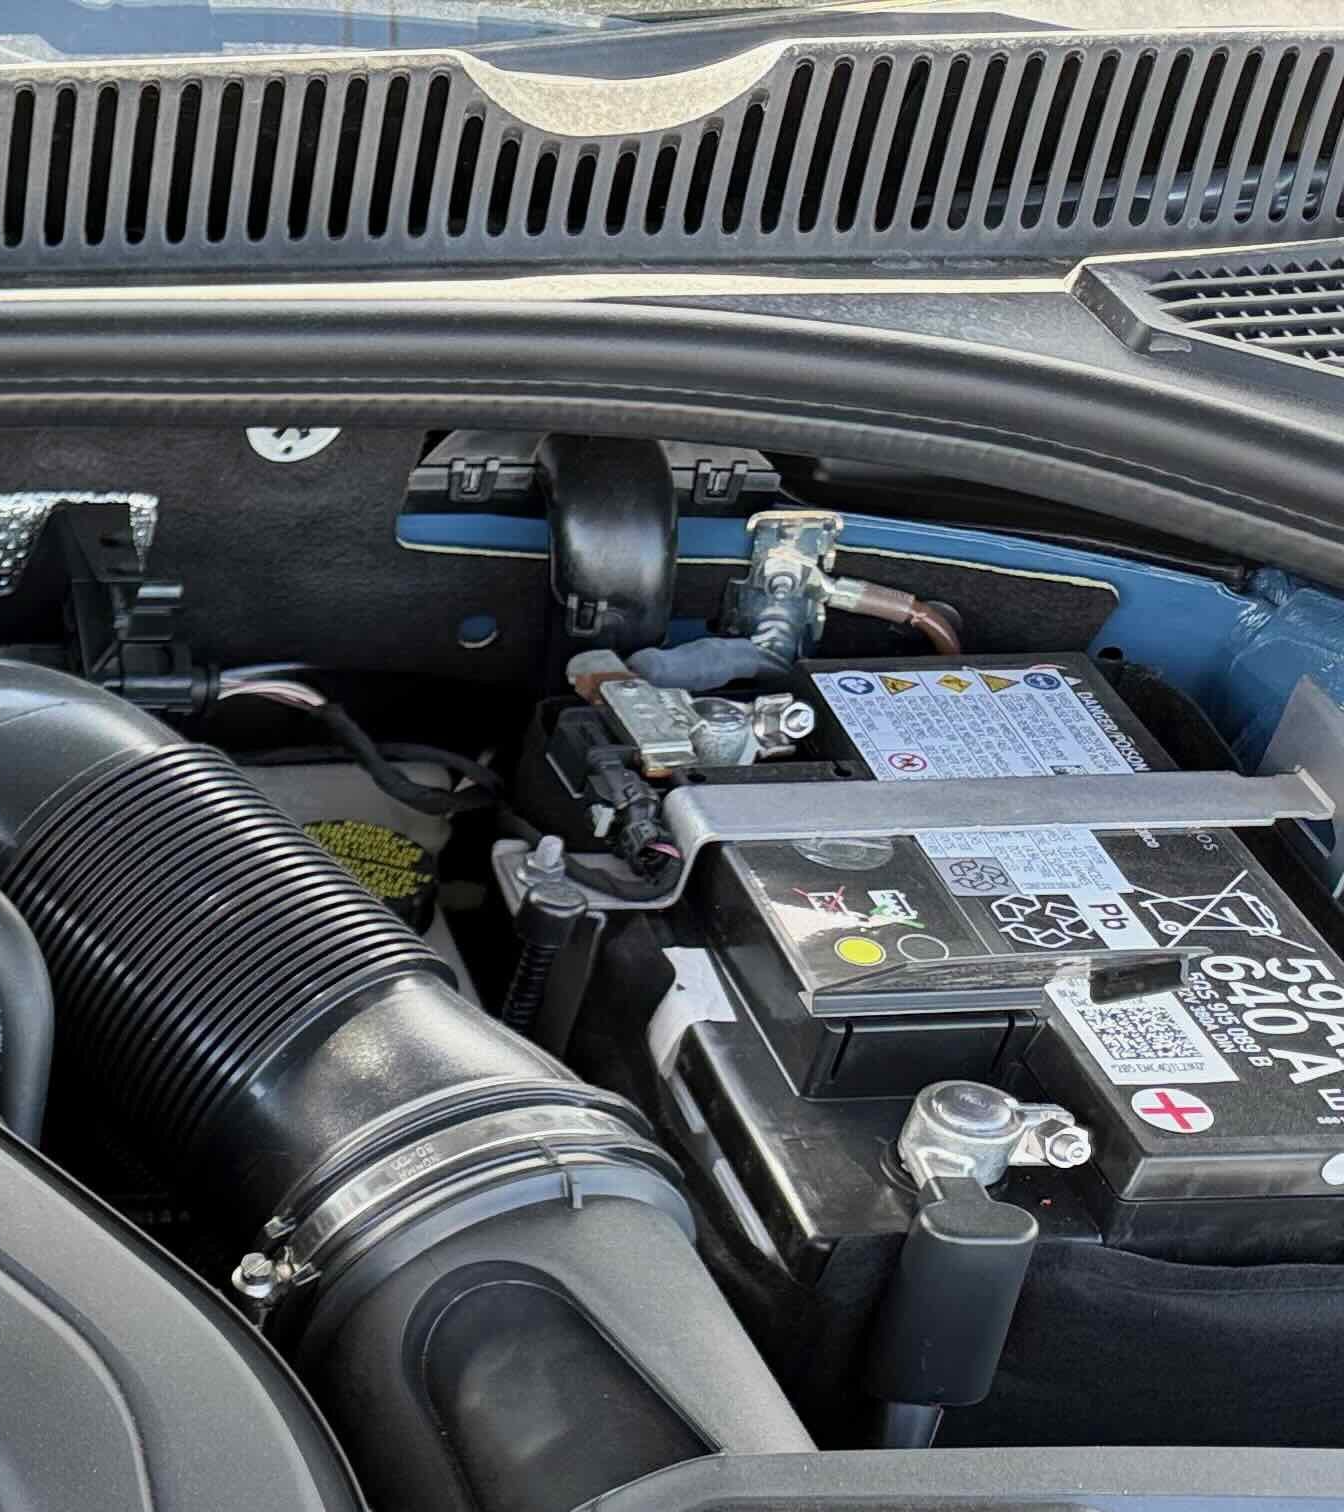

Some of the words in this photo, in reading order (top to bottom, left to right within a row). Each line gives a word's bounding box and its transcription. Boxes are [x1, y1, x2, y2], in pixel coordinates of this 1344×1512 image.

[1087, 903, 1127, 931] Pb
[1200, 955, 1310, 1034] 640
[1268, 1047, 1344, 1085] A
[1207, 1002, 1241, 1025] 915
[1227, 1027, 1262, 1053] 089
[1248, 1056, 1273, 1067] B
[1211, 1033, 1239, 1053] DIN
